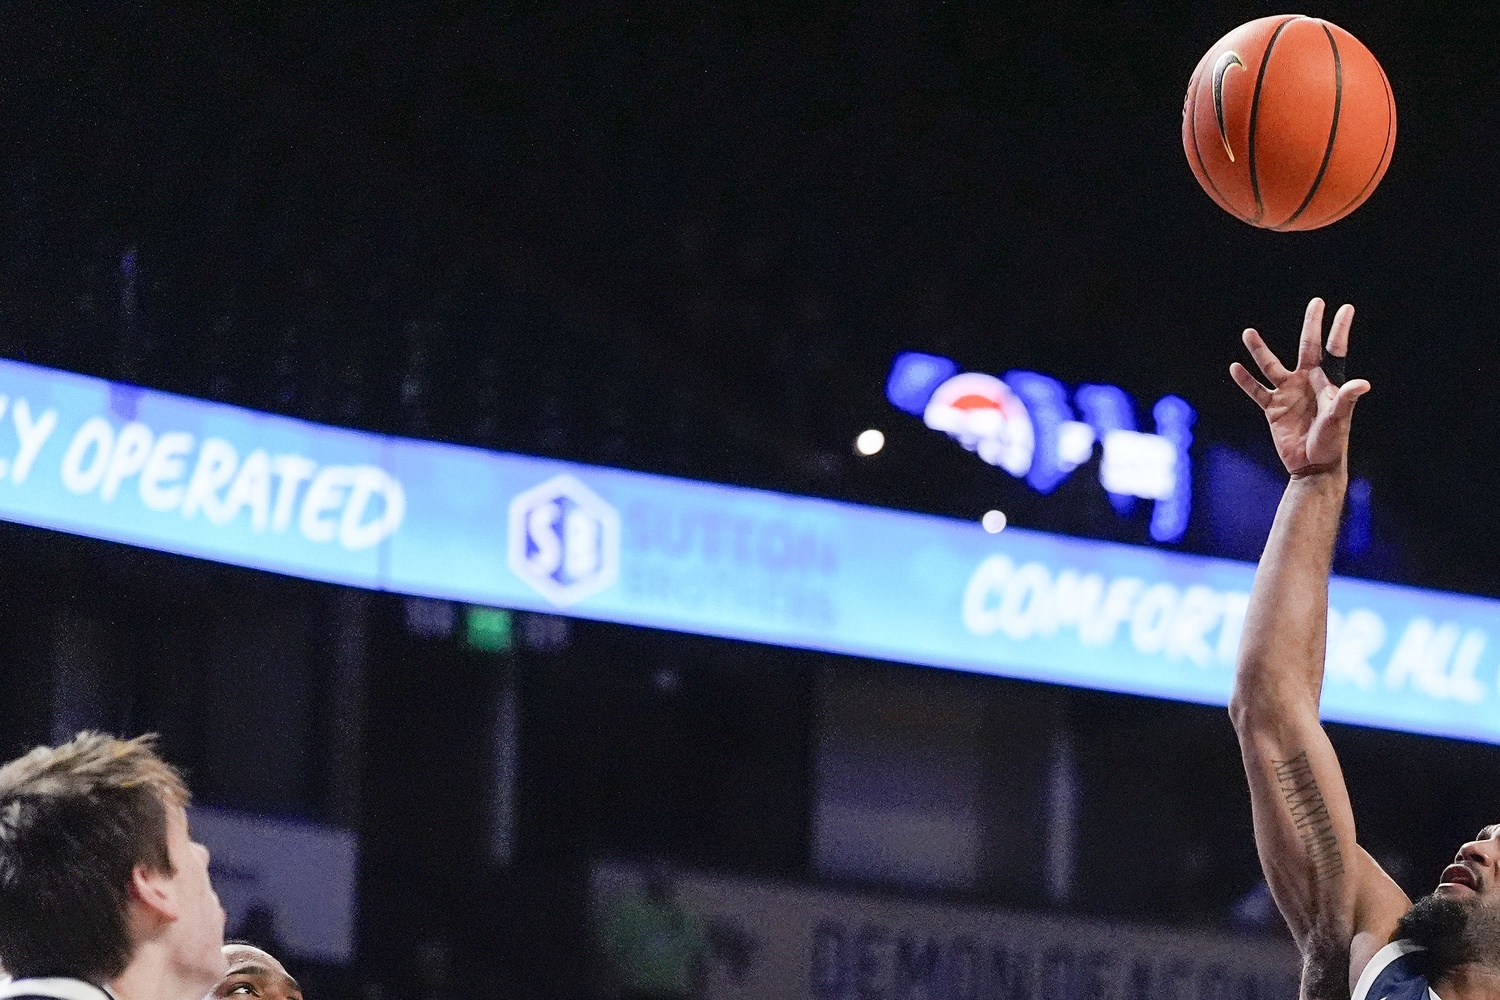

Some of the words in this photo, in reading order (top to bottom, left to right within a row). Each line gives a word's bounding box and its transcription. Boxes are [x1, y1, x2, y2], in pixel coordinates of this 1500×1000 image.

[61, 416, 407, 551] OPERATED
[962, 553, 1248, 668] COMFORT
[1384, 616, 1490, 703] ALL
